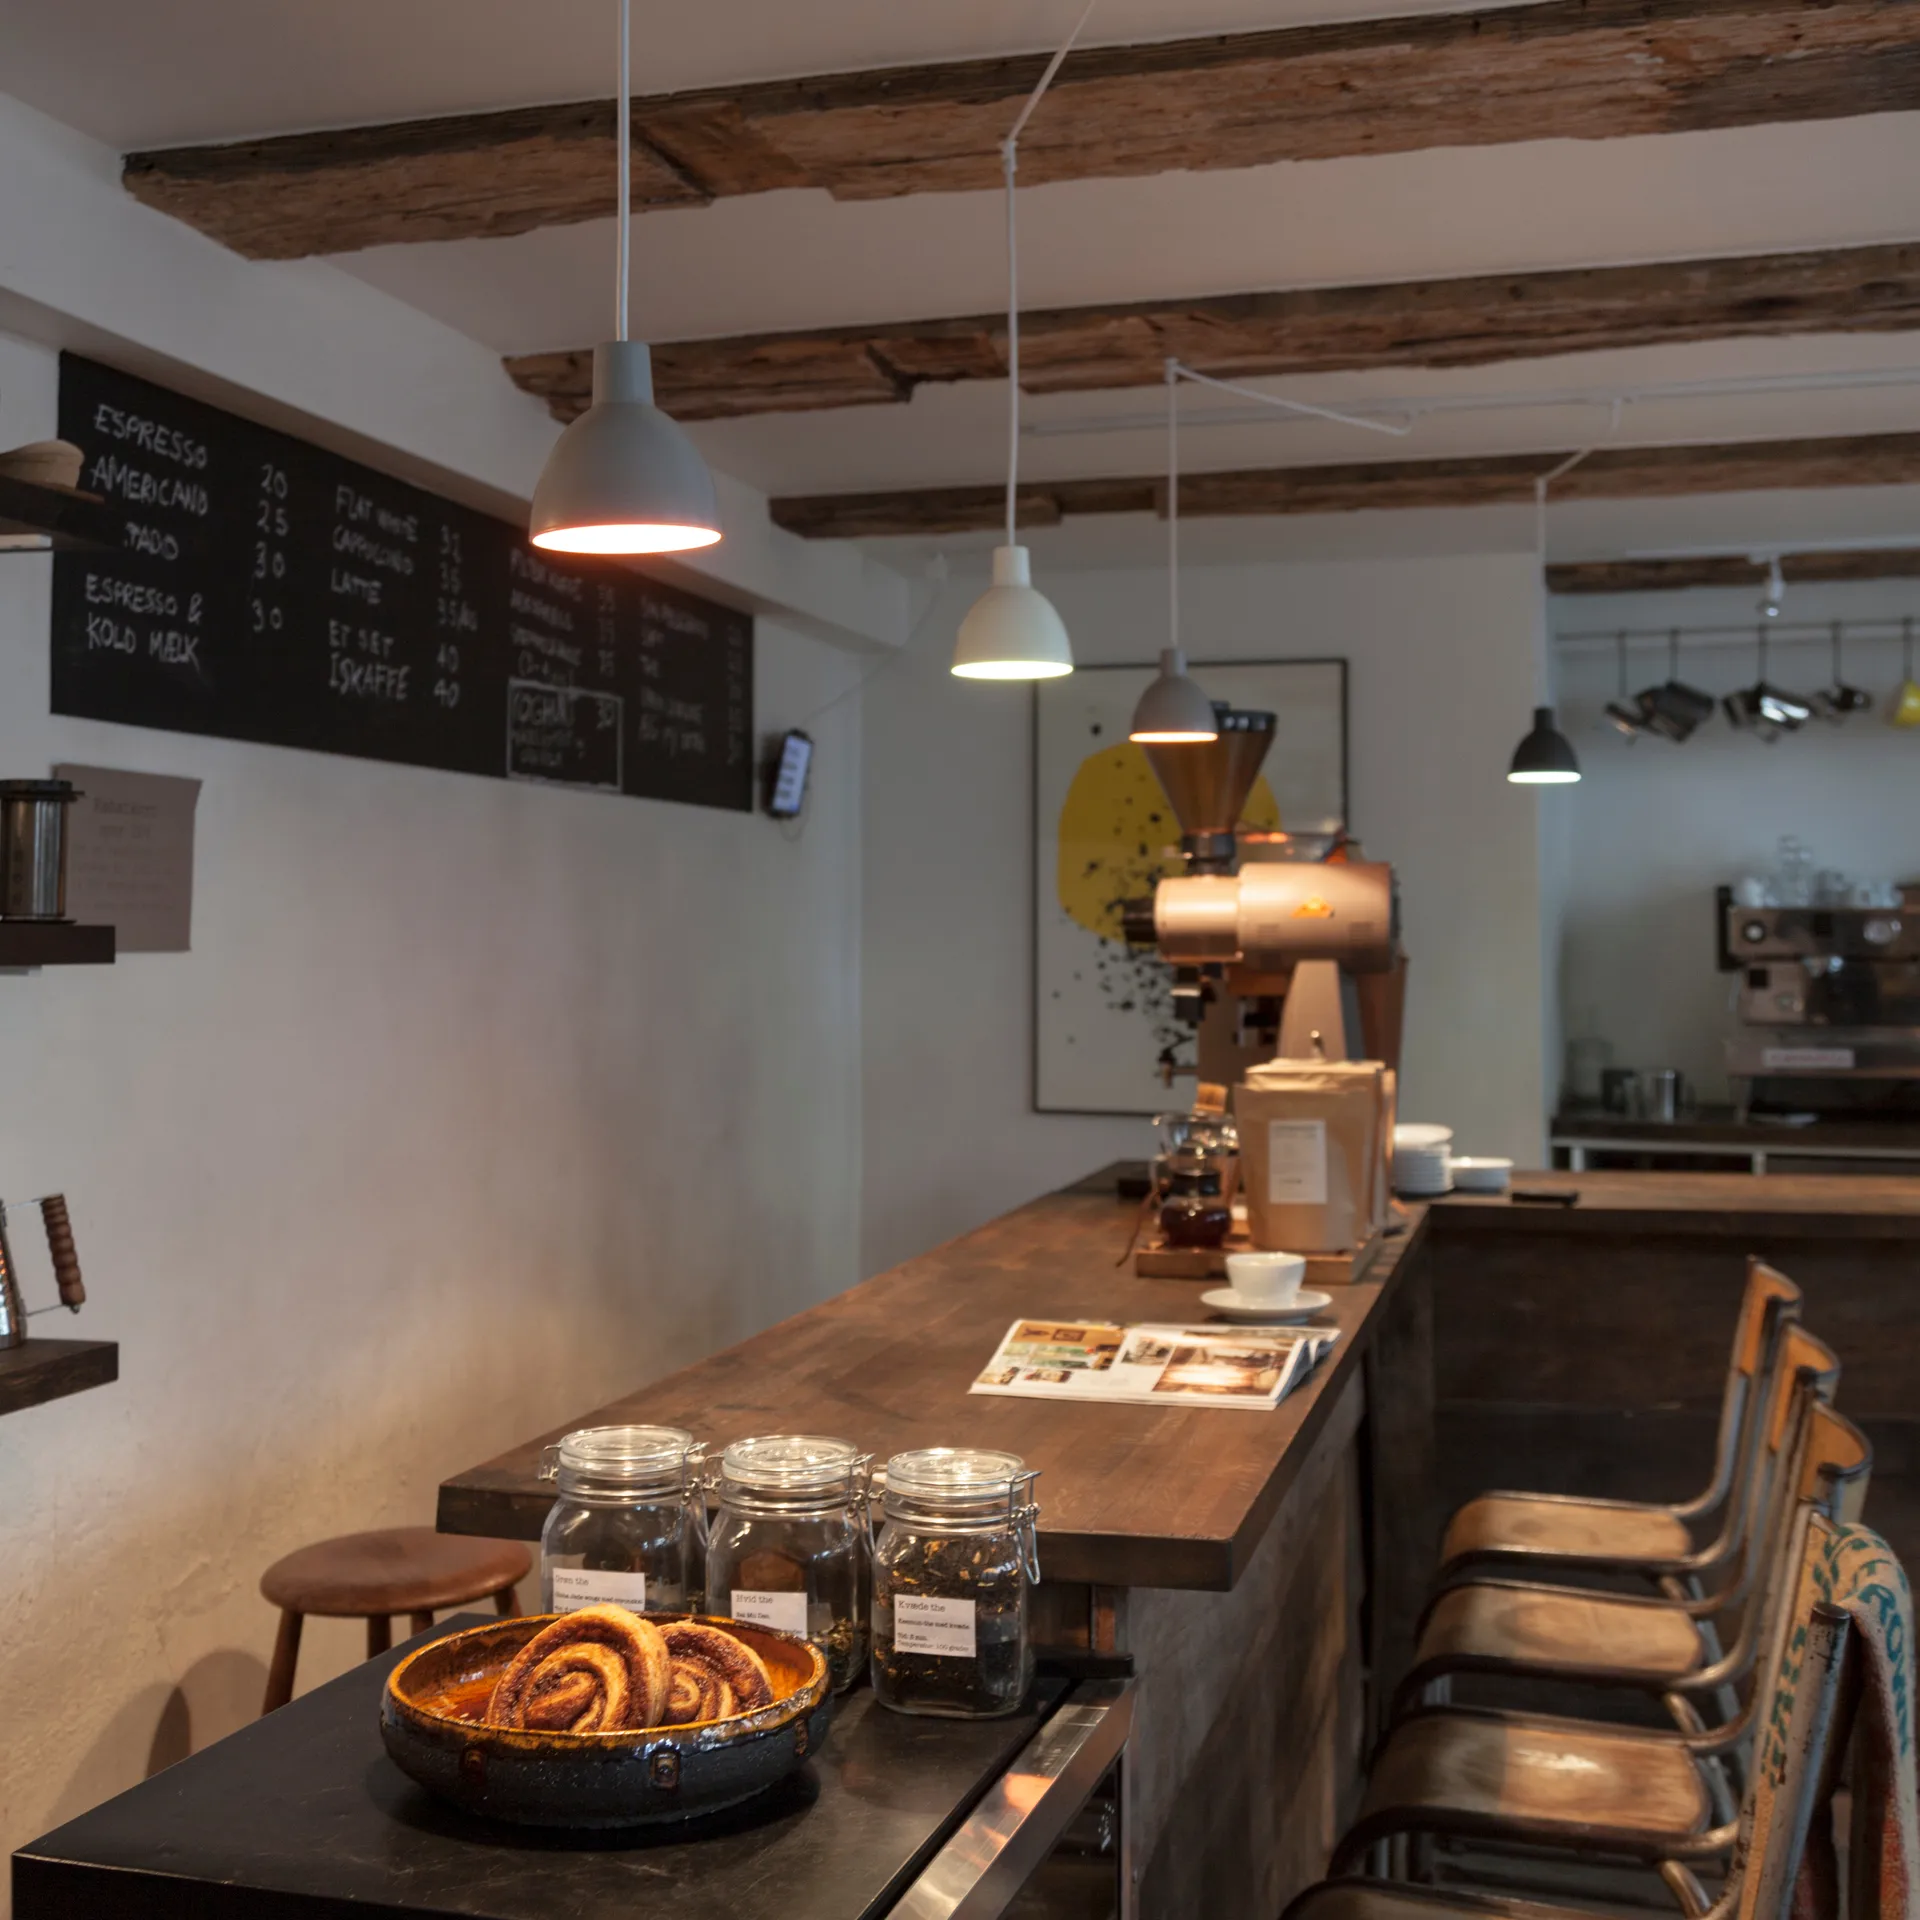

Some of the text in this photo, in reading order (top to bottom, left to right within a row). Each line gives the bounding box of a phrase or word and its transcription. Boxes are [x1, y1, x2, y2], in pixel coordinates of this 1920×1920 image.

[94, 404, 288, 499] ESPRESSO 20
[90, 454, 289, 537] AMERICANO 25
[336, 485, 373, 521] FLAT
[124, 521, 286, 579] TADO 30
[86, 573, 203, 625] ESPRESSO &
[331, 568, 382, 604] LATTE
[87, 612, 137, 655] KOLD
[252, 598, 283, 632] 30
[329, 651, 460, 709] ISKAFFE 40
[736, 1594, 774, 1604] Hvid the
[898, 1600, 946, 1612] Kvæde the
